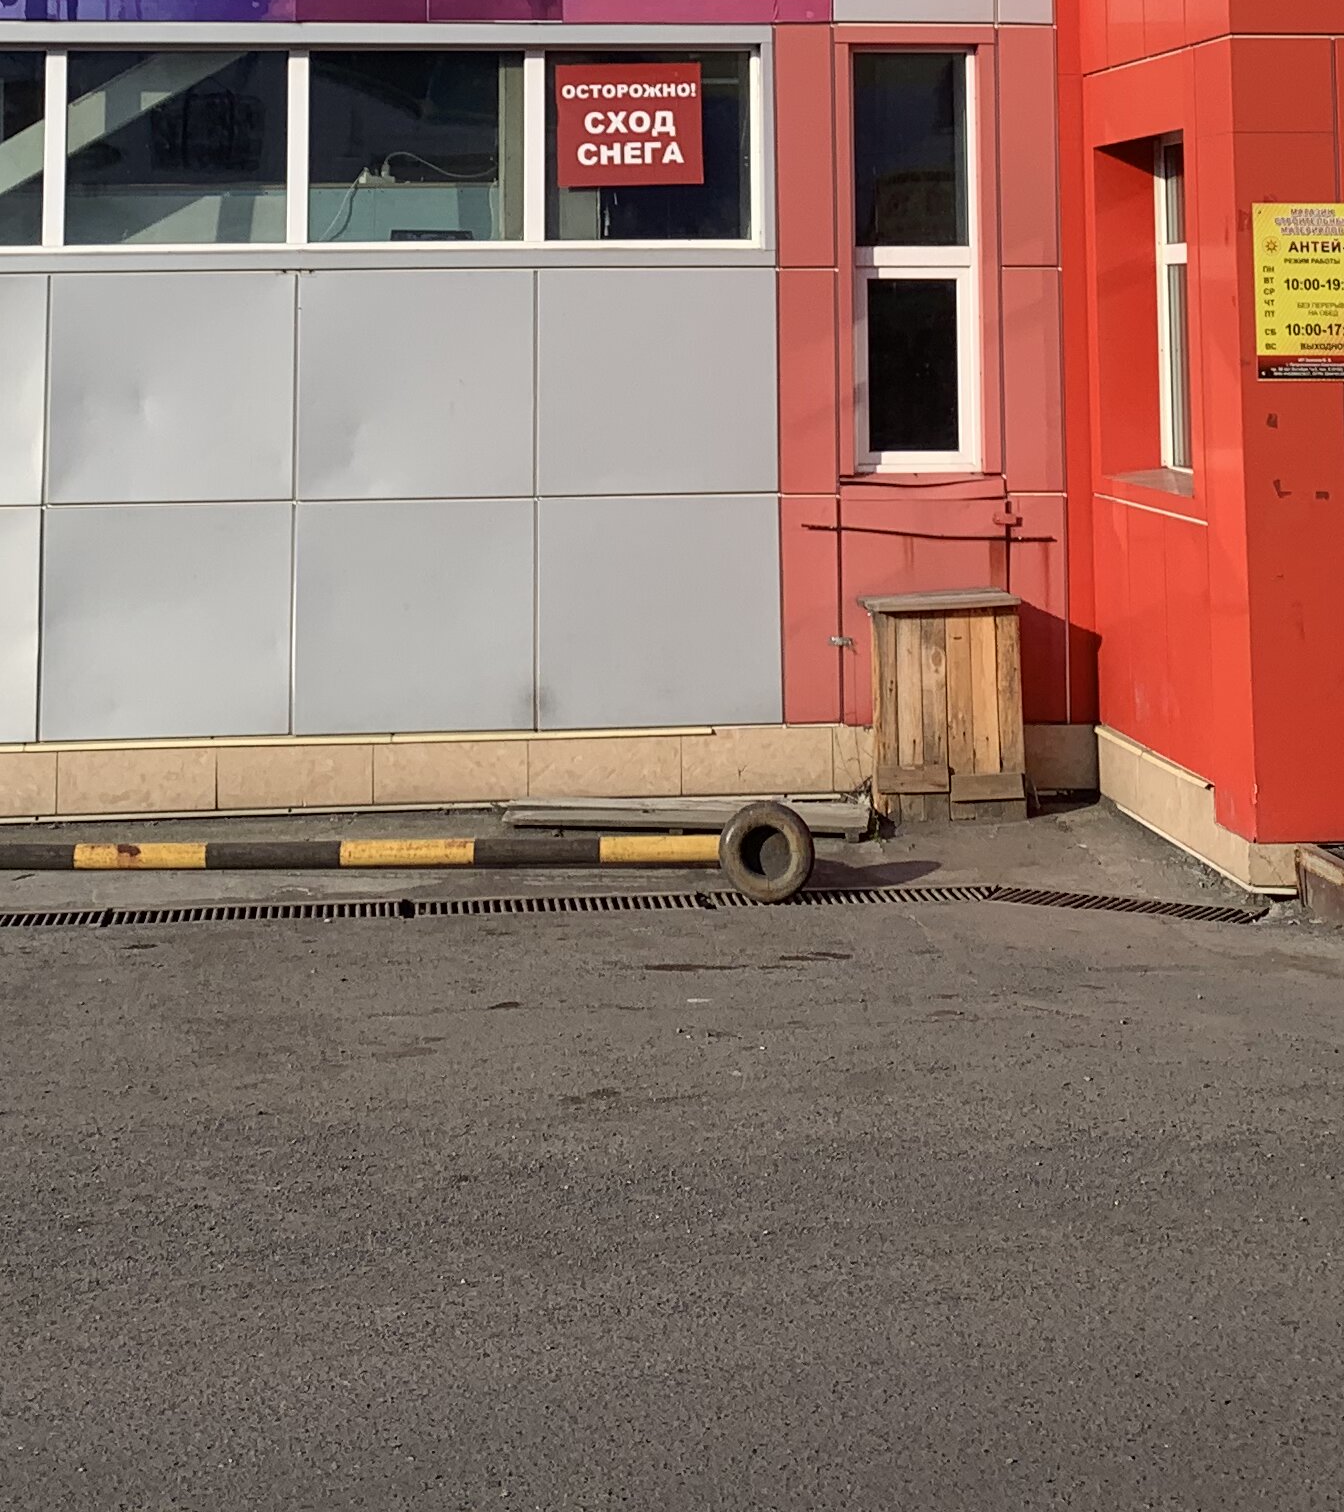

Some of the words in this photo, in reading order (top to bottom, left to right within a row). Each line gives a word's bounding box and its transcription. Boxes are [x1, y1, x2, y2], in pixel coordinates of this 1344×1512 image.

[561, 82, 697, 99] ОСТОРОЖНО!
[584, 110, 676, 137] СХОД
[577, 141, 684, 165] СНЕГА
[1284, 257, 1309, 265] РЕЖИМ
[1310, 257, 1341, 265] РАБОТЫ
[1262, 265, 1275, 273] ПН
[1263, 288, 1275, 296] СР
[1264, 299, 1275, 307] ЧТ
[1264, 310, 1275, 318] ПТ
[1264, 328, 1276, 336] СБ
